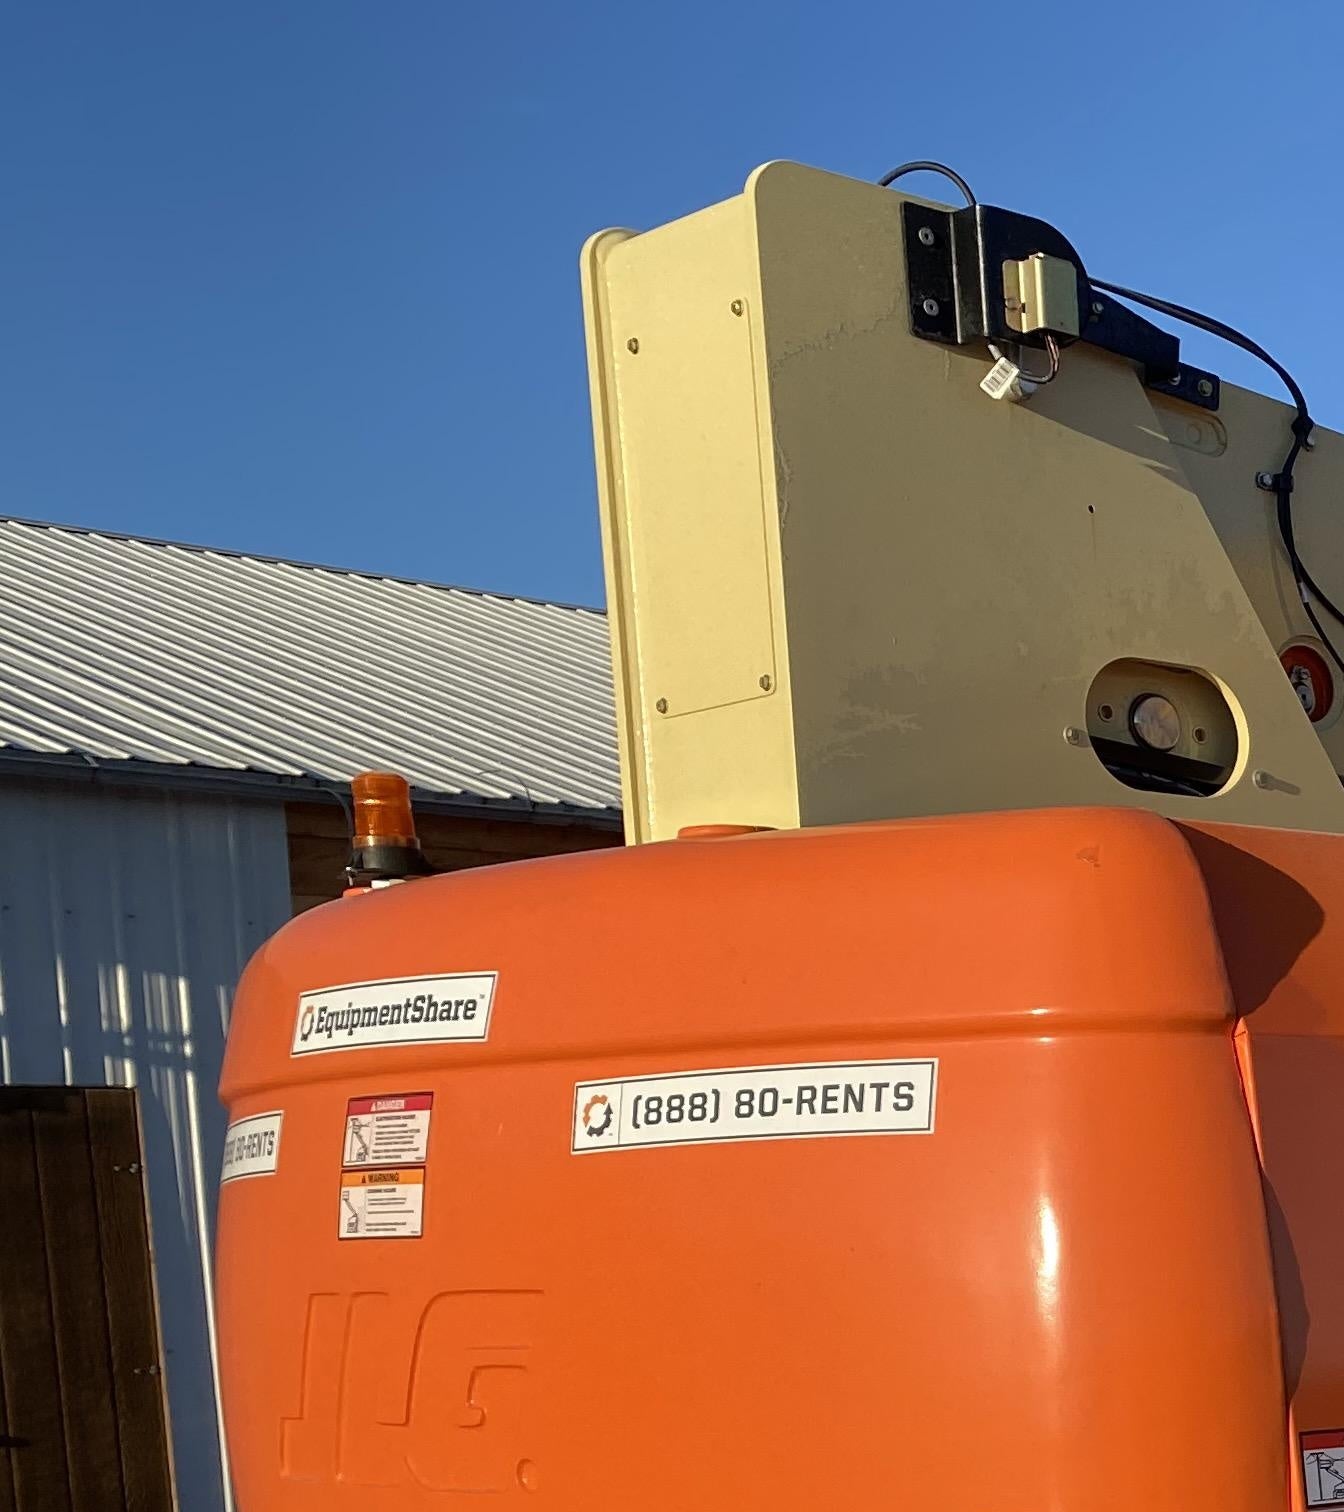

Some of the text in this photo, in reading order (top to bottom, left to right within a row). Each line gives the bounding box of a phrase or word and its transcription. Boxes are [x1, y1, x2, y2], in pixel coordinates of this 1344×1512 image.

[315, 994, 478, 1039] EquipmentShare
[632, 1081, 915, 1129] (888) 80-RENTS
